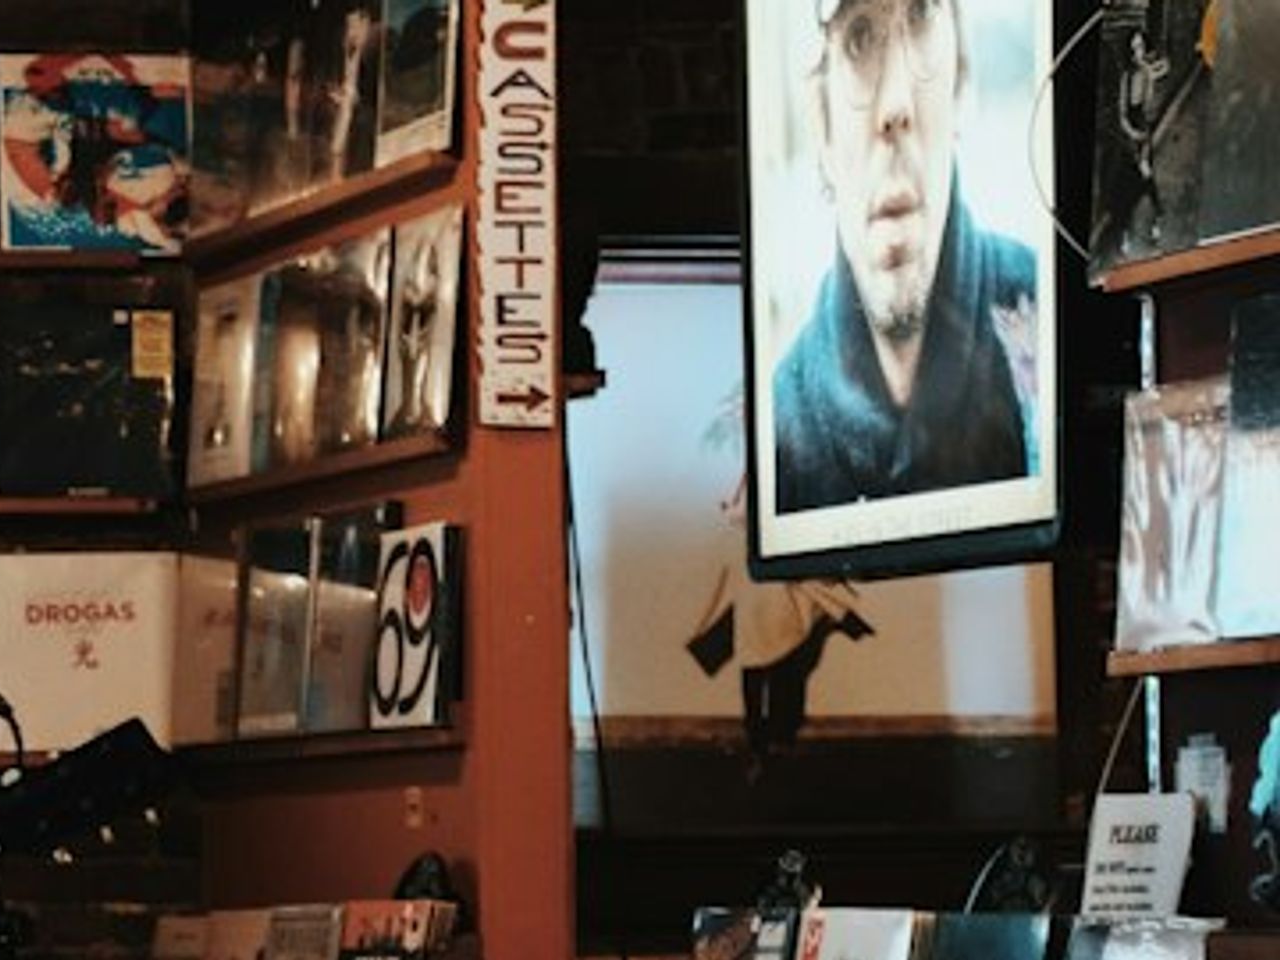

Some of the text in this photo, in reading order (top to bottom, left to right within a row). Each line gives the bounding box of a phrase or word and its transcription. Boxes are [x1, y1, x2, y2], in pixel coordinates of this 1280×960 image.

[490, 20, 551, 364] CASSETTES
[25, 601, 136, 625] DROGAS
[1109, 823, 1160, 844] PLEASE
